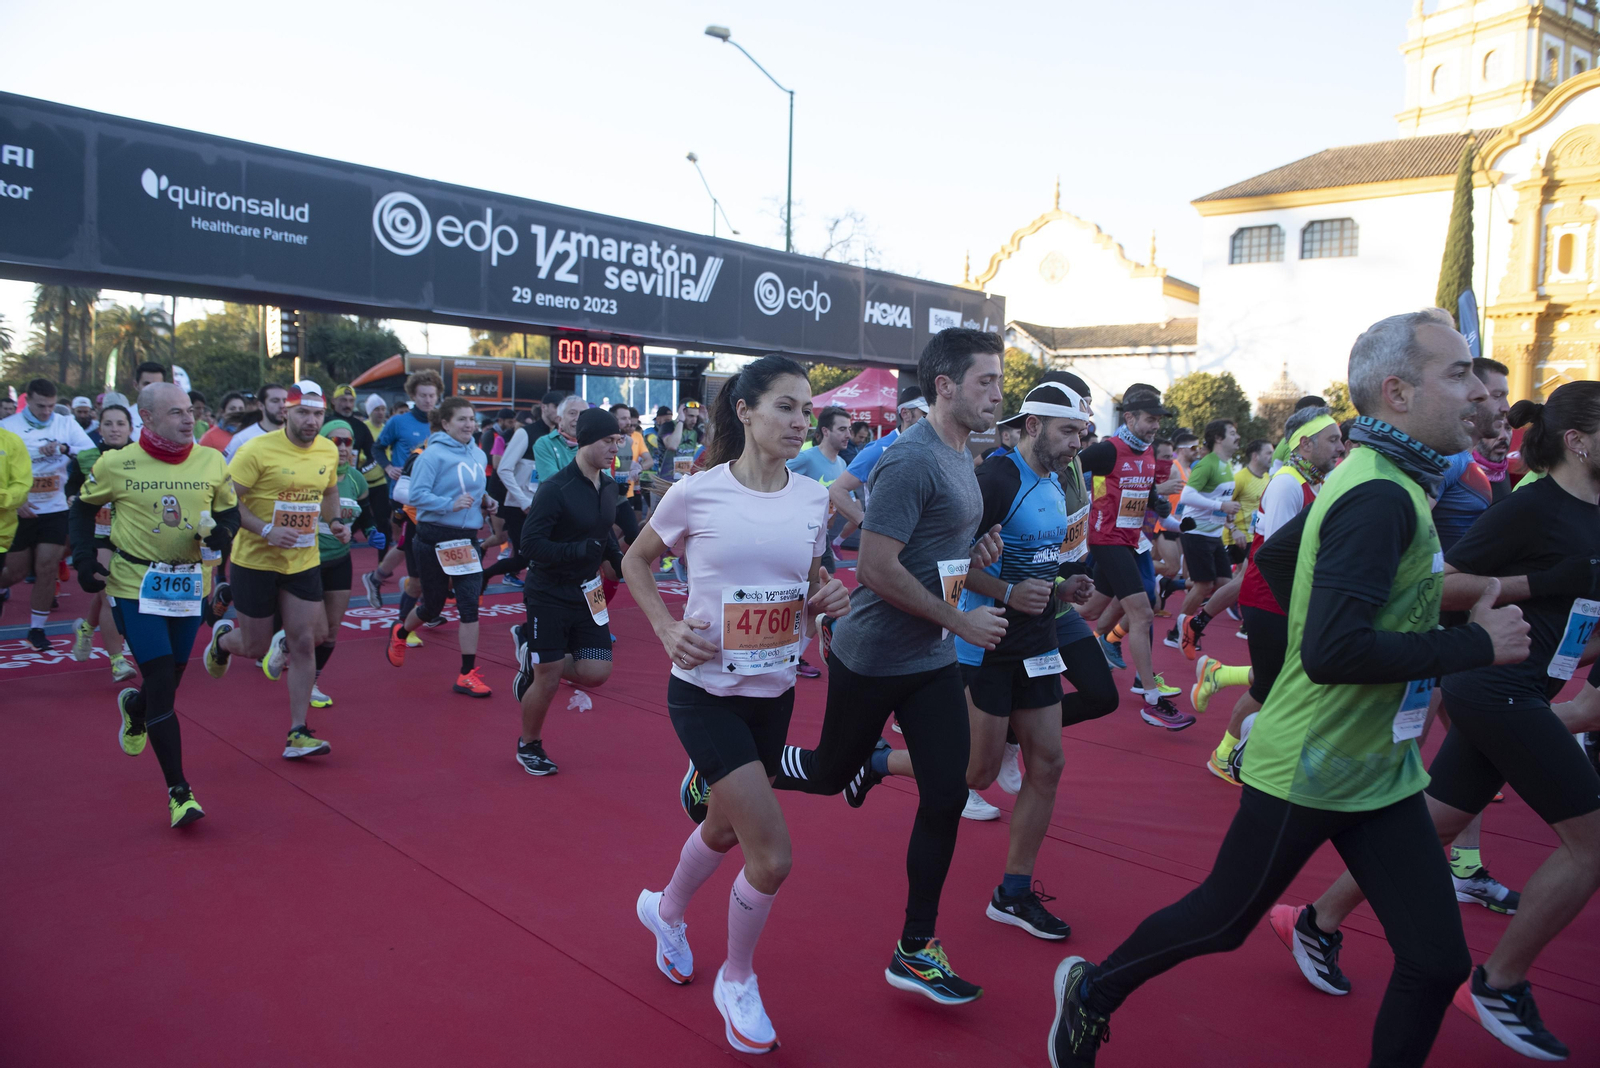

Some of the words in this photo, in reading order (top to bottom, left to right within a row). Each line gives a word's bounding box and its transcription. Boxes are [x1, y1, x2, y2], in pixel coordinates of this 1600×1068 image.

[191, 216, 261, 238] Healthcare
[263, 227, 308, 245] Partner
[436, 207, 519, 266] edp
[570, 231, 697, 276] maratón
[604, 265, 698, 302] sevilla
[512, 286, 532, 304] 29
[535, 291, 580, 311] enero
[583, 296, 618, 315] 2023
[787, 280, 831, 322] edp
[864, 301, 913, 329] HOKA
[125, 479, 210, 493] Paparunners
[281, 513, 312, 528] 3833
[443, 548, 469, 562] 3651
[151, 575, 191, 593] 3166
[745, 590, 763, 601] edp
[736, 607, 791, 635] 4760
